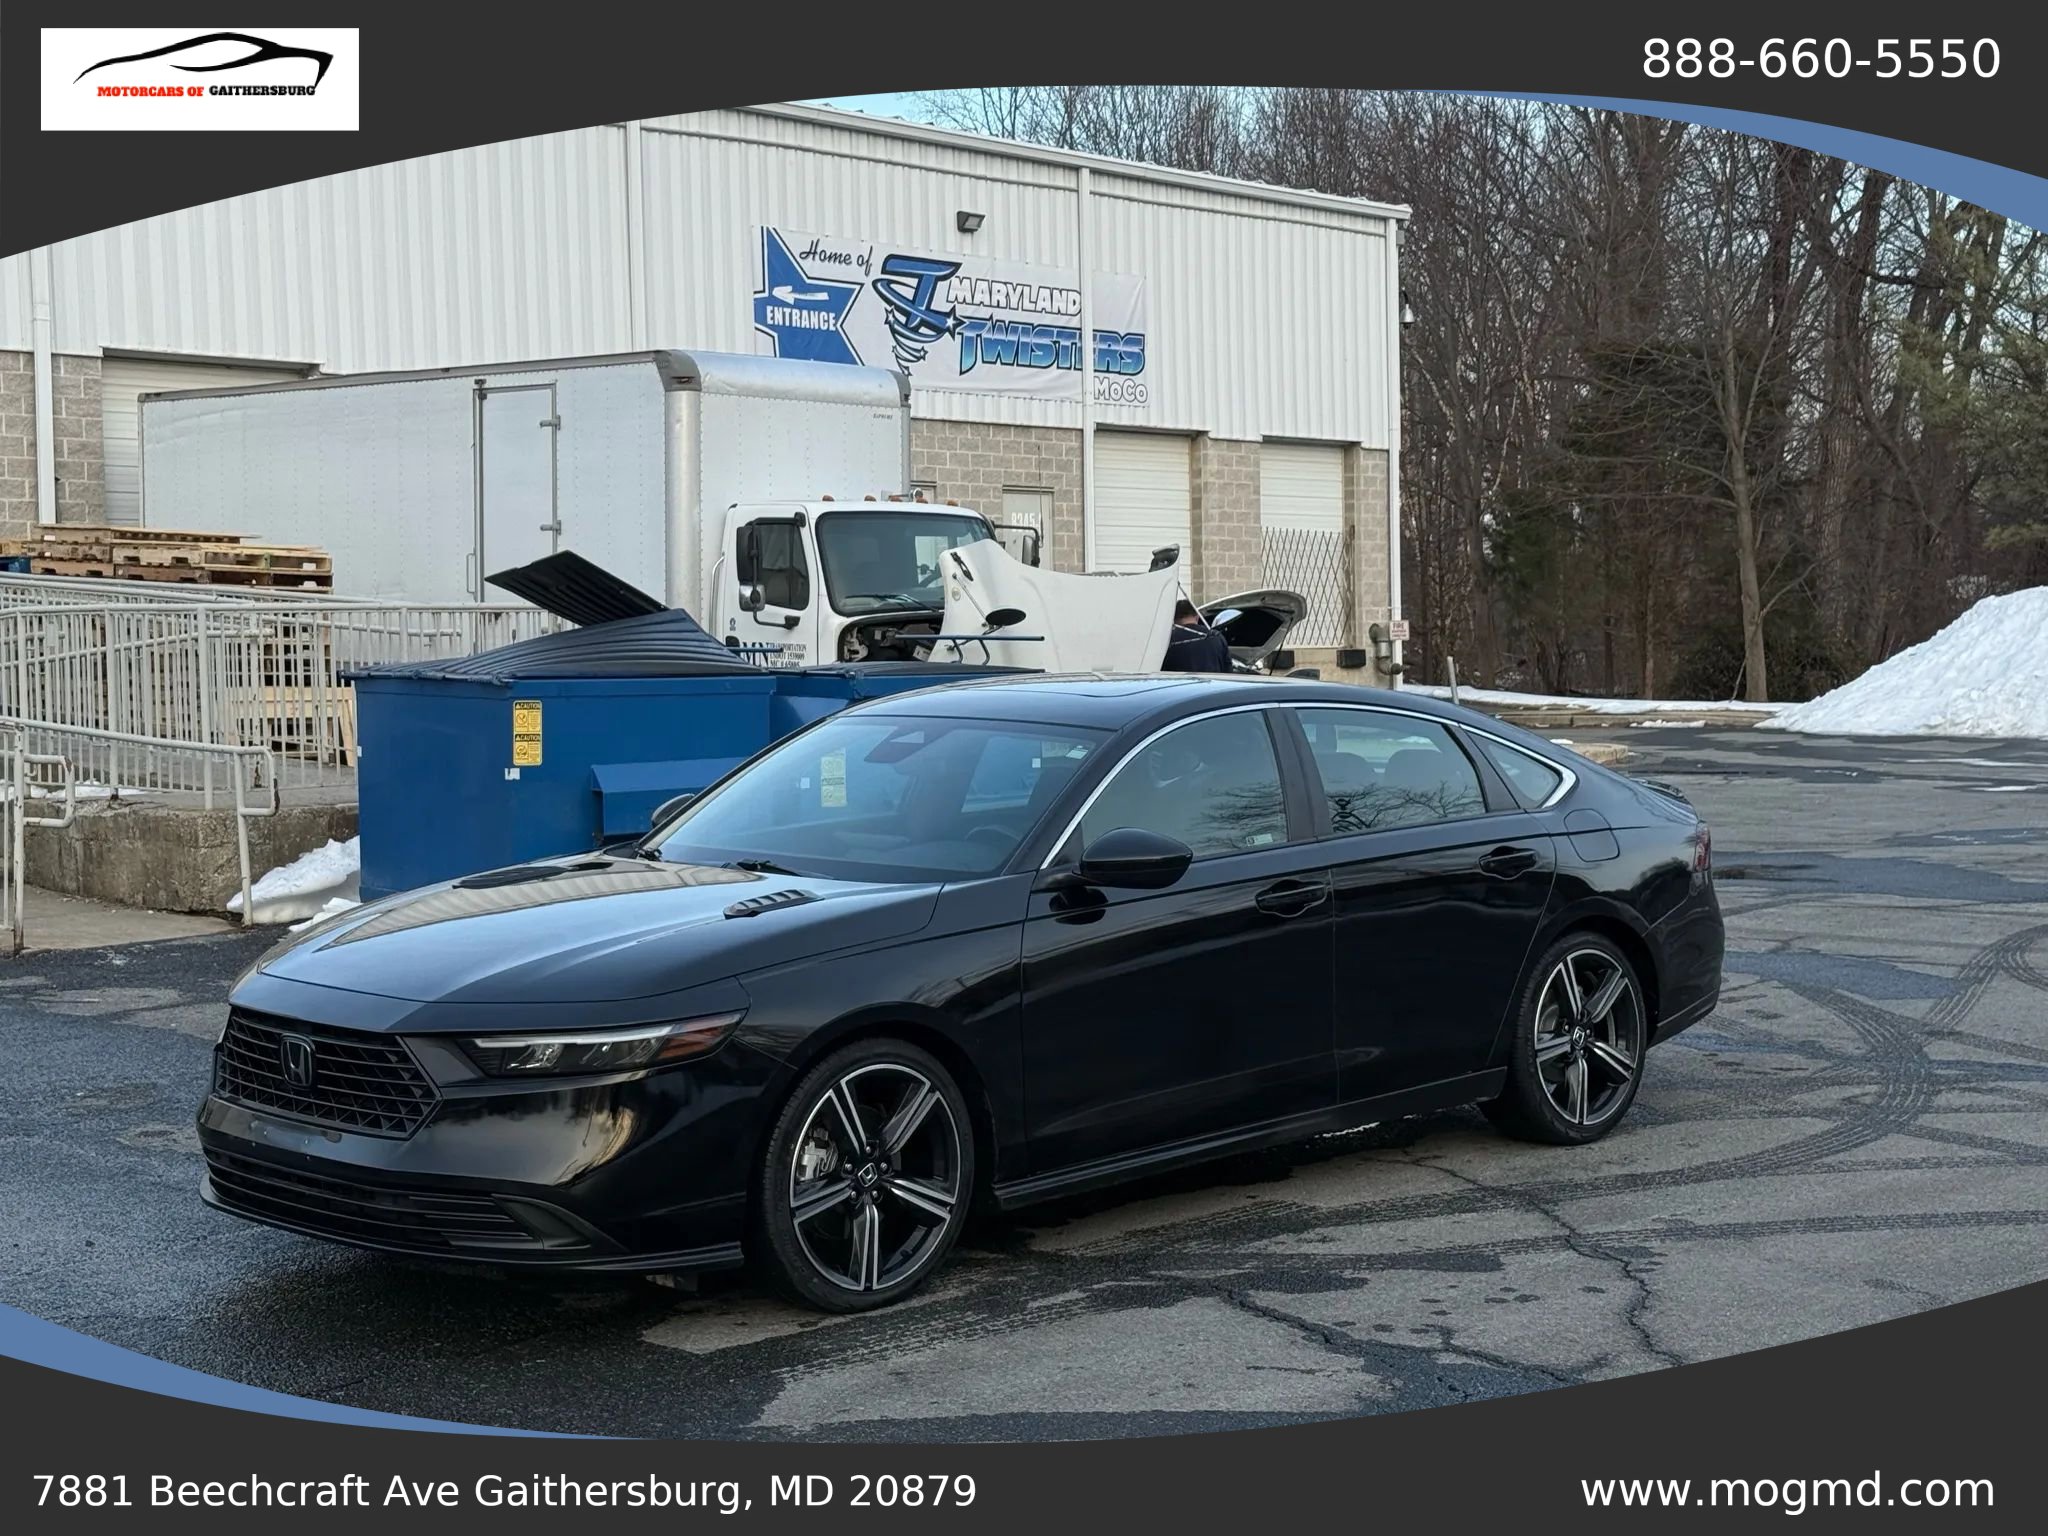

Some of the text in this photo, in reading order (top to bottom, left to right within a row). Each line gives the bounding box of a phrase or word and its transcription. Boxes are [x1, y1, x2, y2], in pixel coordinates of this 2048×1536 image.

[800, 239, 873, 277] Home of
[946, 276, 1082, 317] MARYLAND
[766, 305, 837, 331] ENTRANCE
[1093, 377, 1149, 403] MoCo
